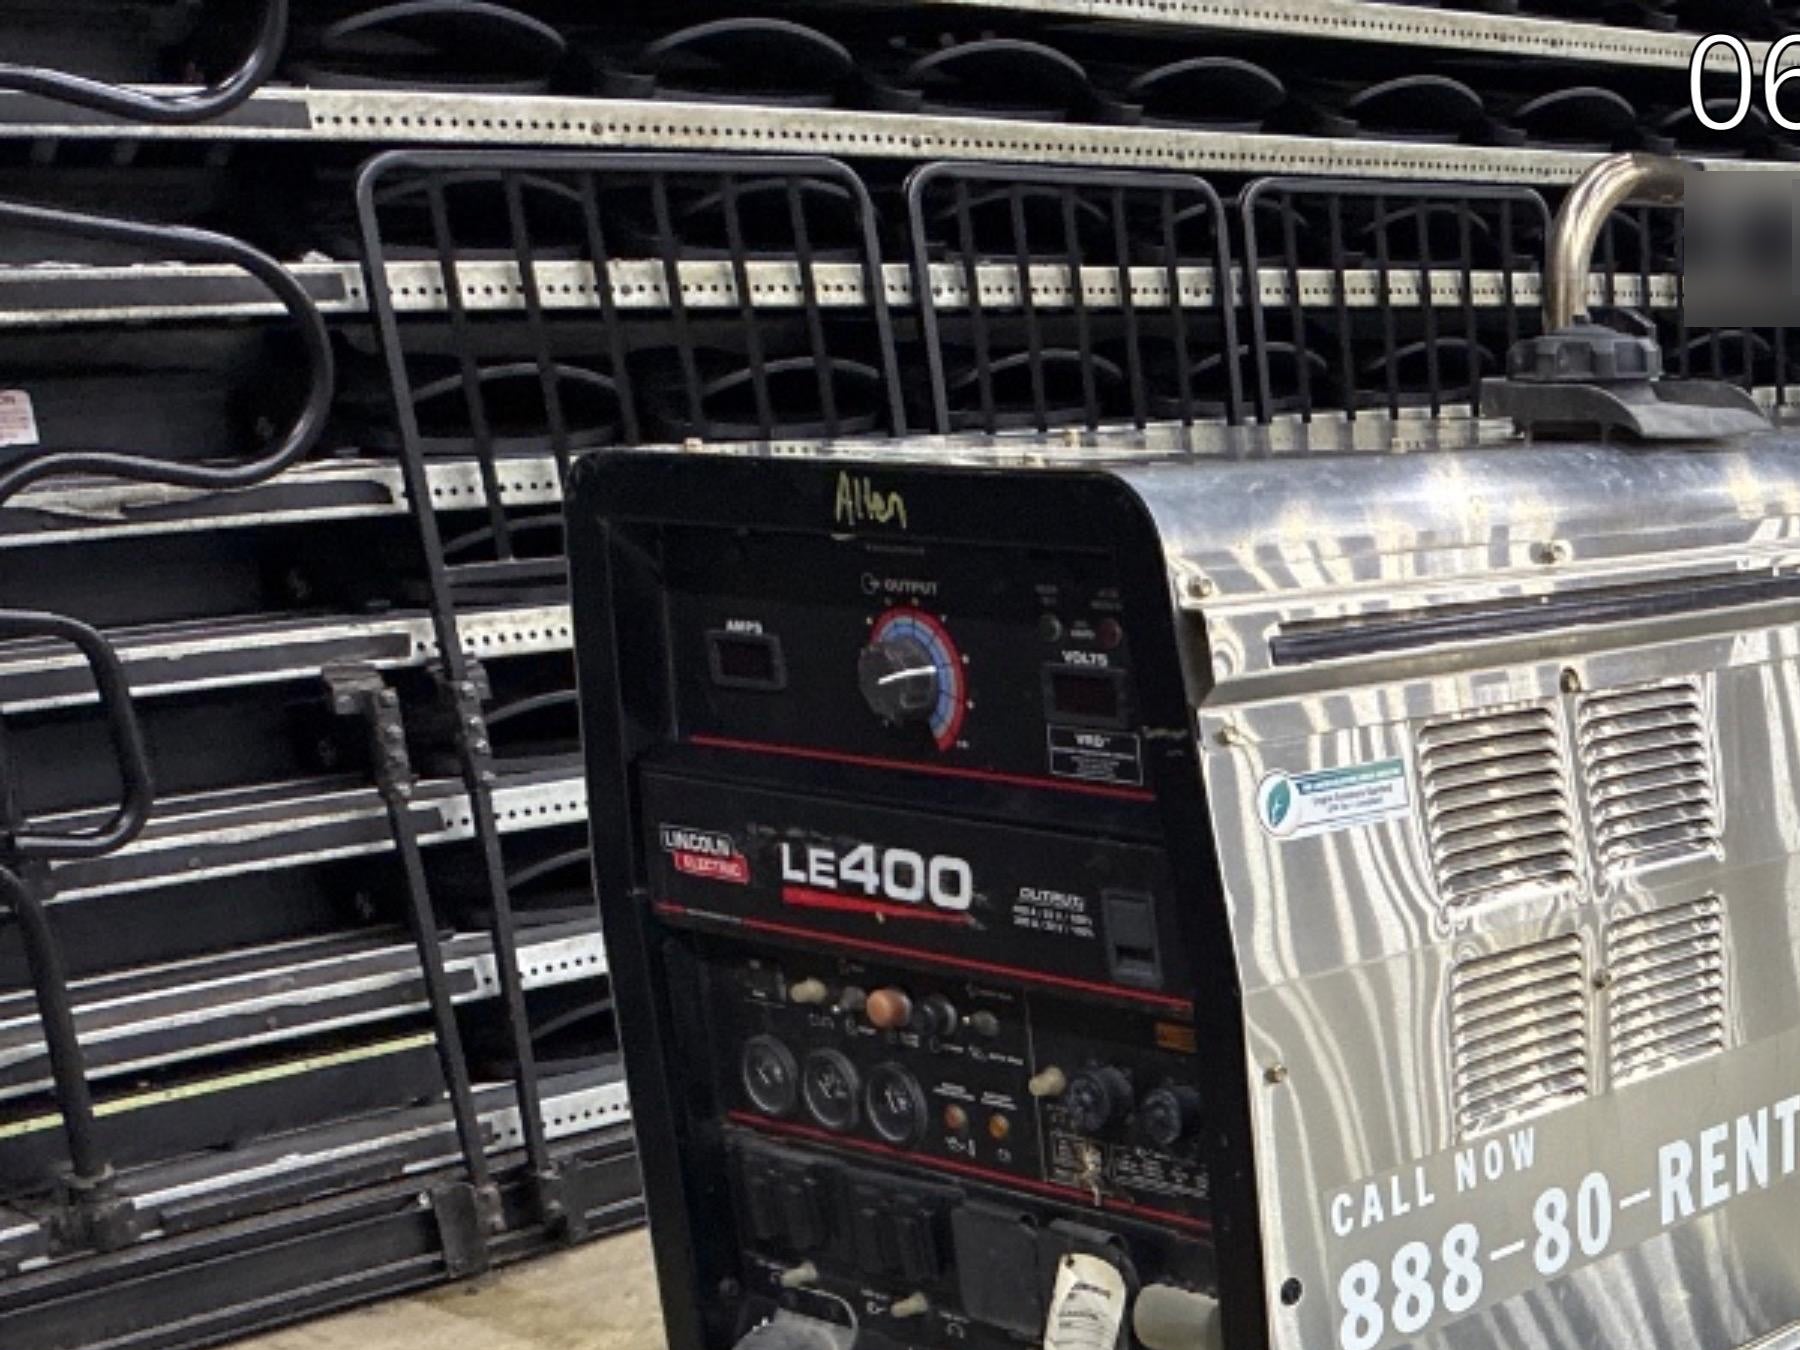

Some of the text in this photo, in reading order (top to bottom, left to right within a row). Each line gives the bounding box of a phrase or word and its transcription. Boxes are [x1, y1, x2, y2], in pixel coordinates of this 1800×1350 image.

[884, 580, 937, 595] OUTPUT
[726, 619, 763, 636] AMPS
[1062, 650, 1109, 667] VOLTS
[664, 829, 730, 856] LINCOLN
[682, 855, 741, 878] ELECTRIC
[780, 841, 973, 911] LE400
[1330, 1128, 1537, 1236] CALL NOW
